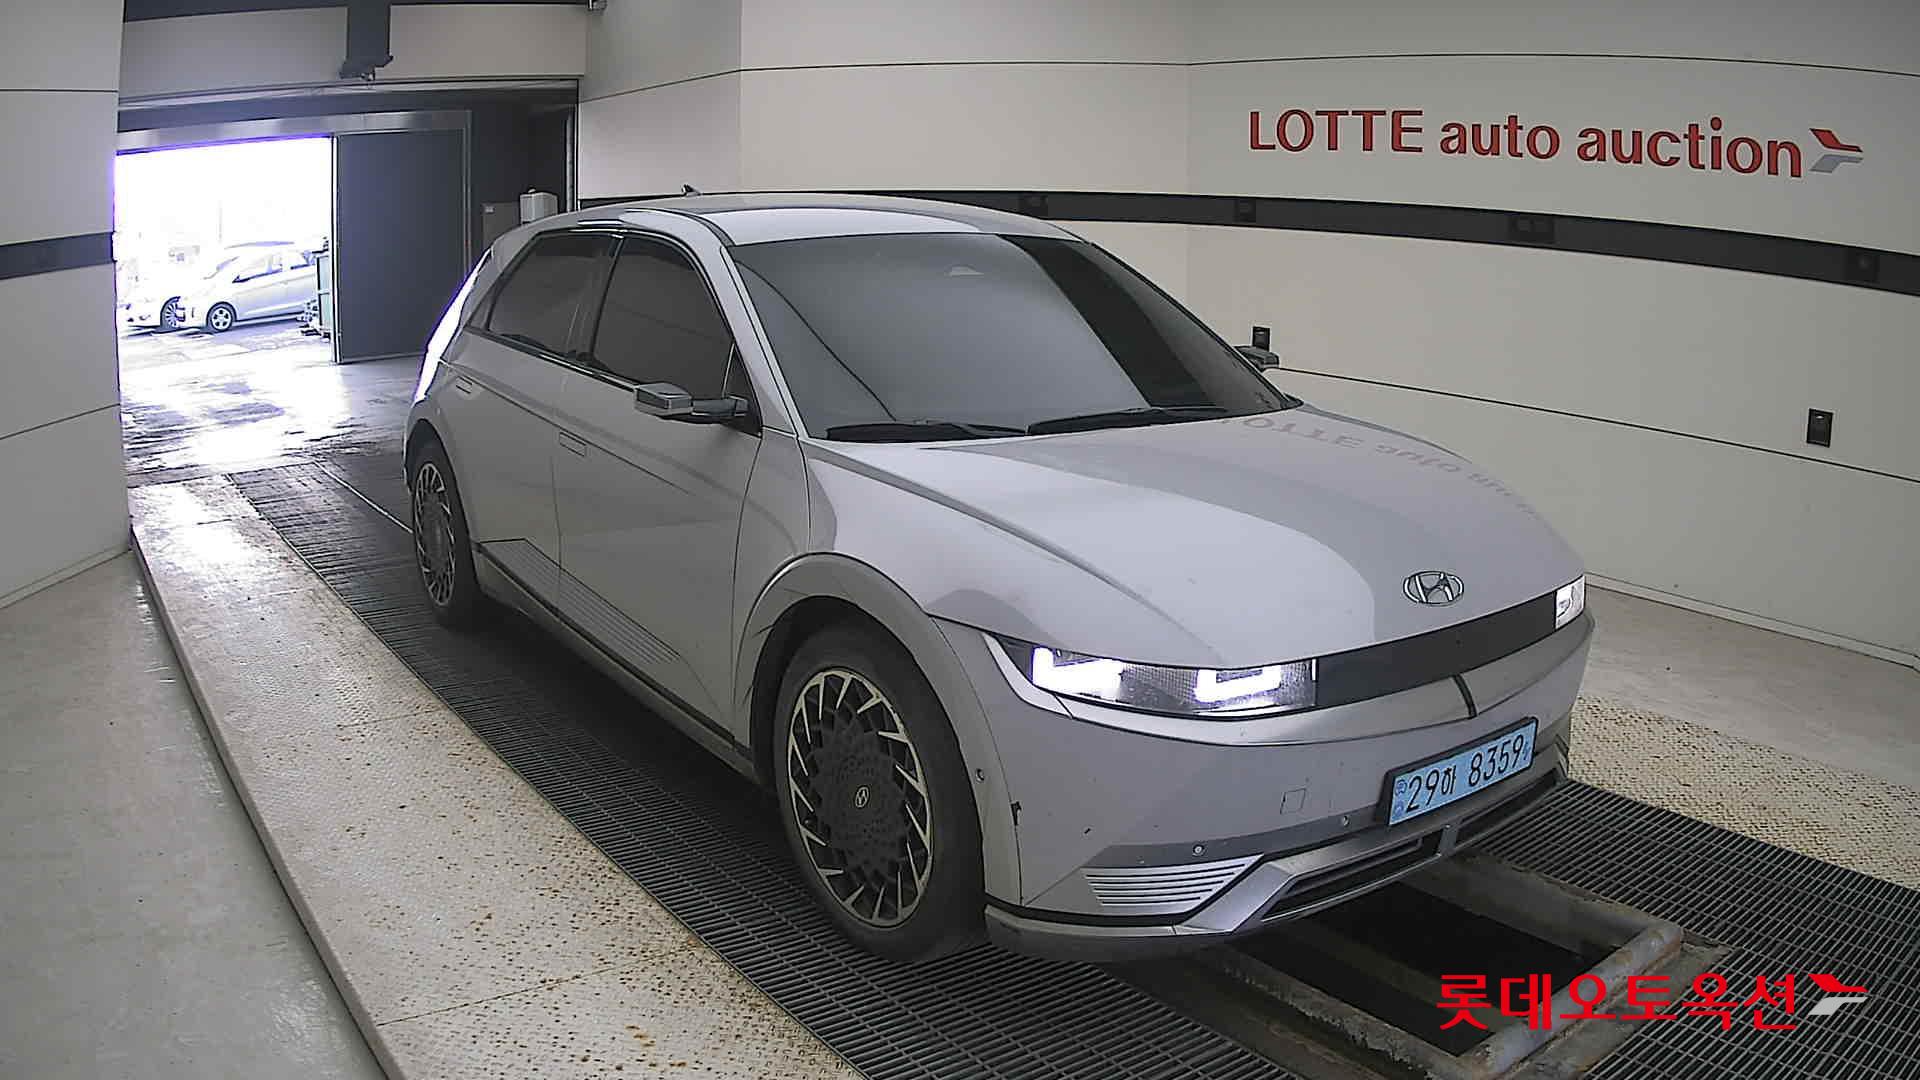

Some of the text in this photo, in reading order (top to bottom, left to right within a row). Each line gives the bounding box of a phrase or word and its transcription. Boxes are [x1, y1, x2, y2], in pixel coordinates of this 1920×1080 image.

[1249, 110, 1802, 177] LOTTE auto auction
[1406, 735, 1524, 813] 29하 8359
